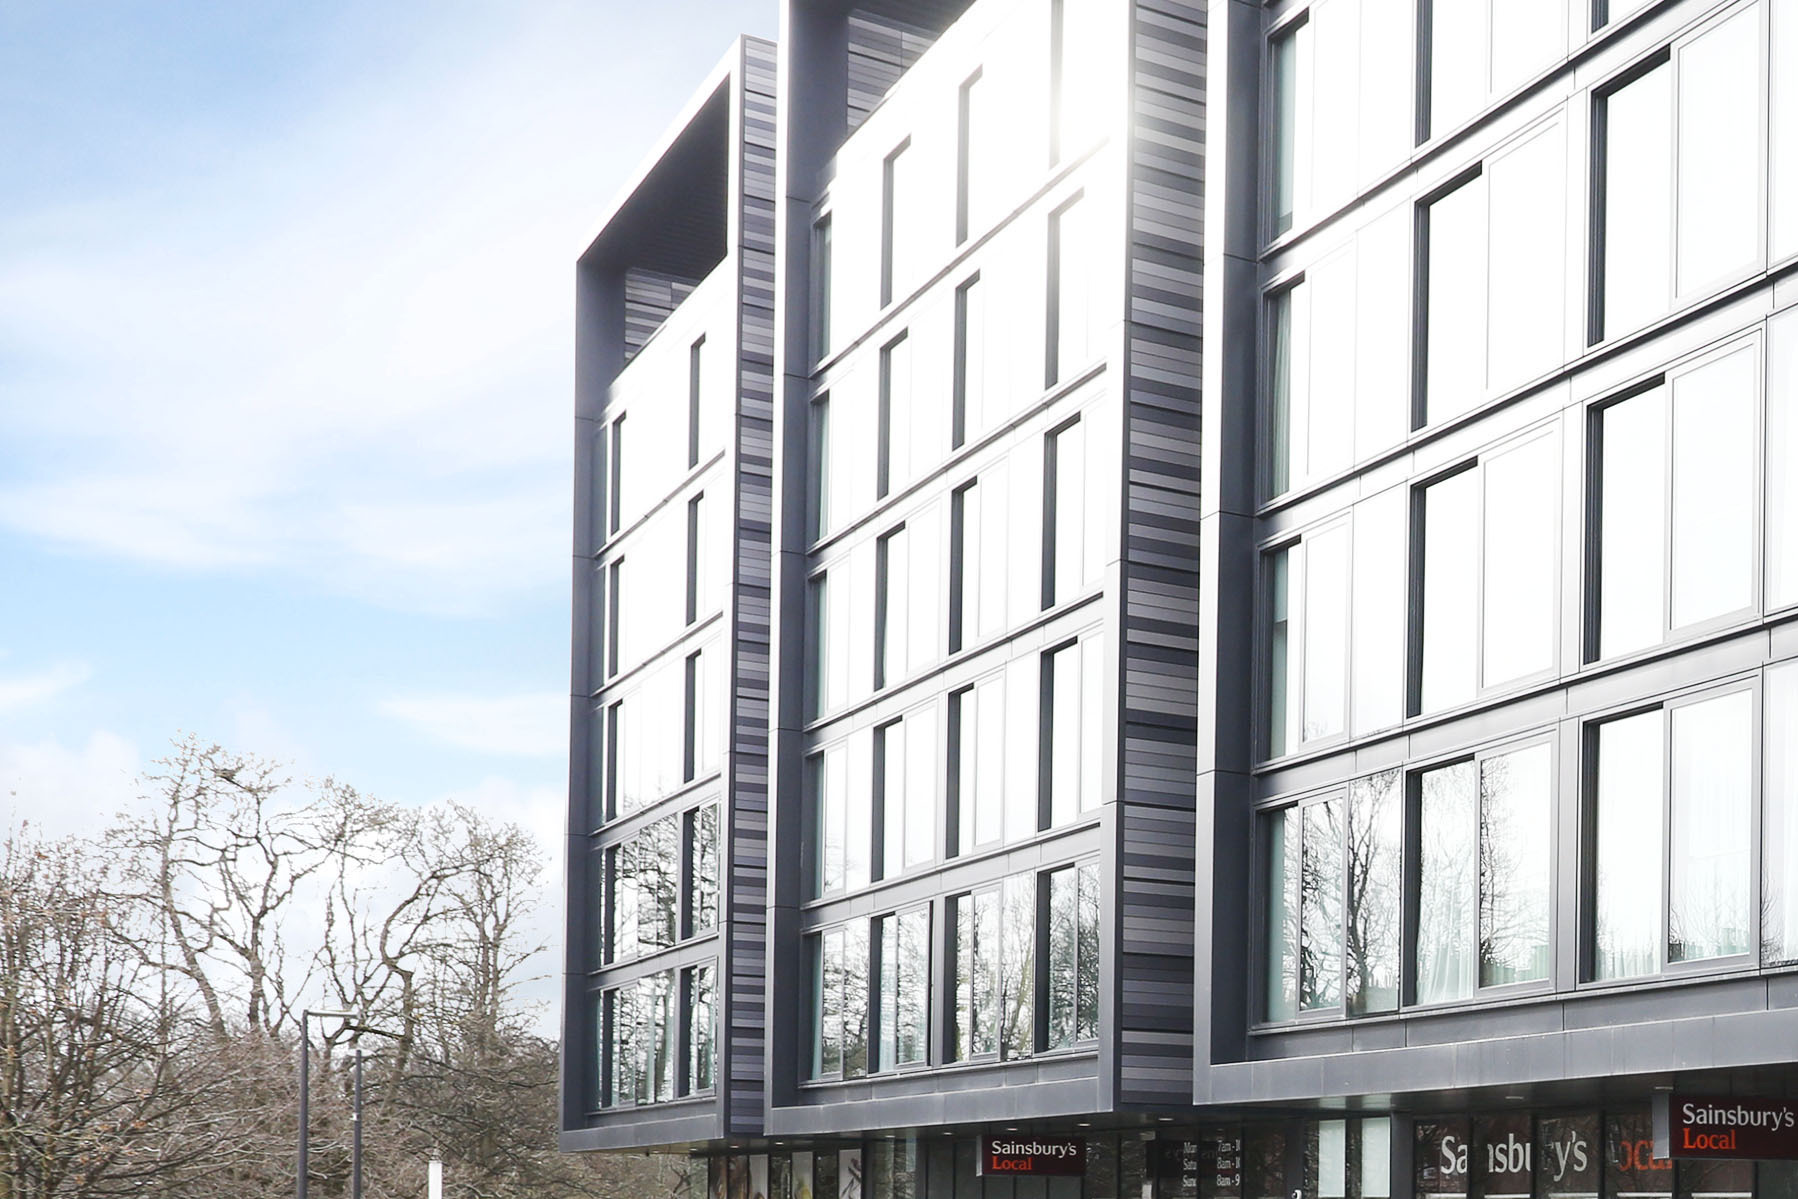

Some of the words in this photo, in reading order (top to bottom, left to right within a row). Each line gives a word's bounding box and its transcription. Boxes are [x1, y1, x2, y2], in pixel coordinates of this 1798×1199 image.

[1682, 1103, 1795, 1131] Sainsbury's
[1683, 1127, 1737, 1150] Local
[992, 1140, 1077, 1158] Sainsbury's
[992, 1155, 1033, 1170] Local
[1216, 1174, 1231, 1186] 8am
